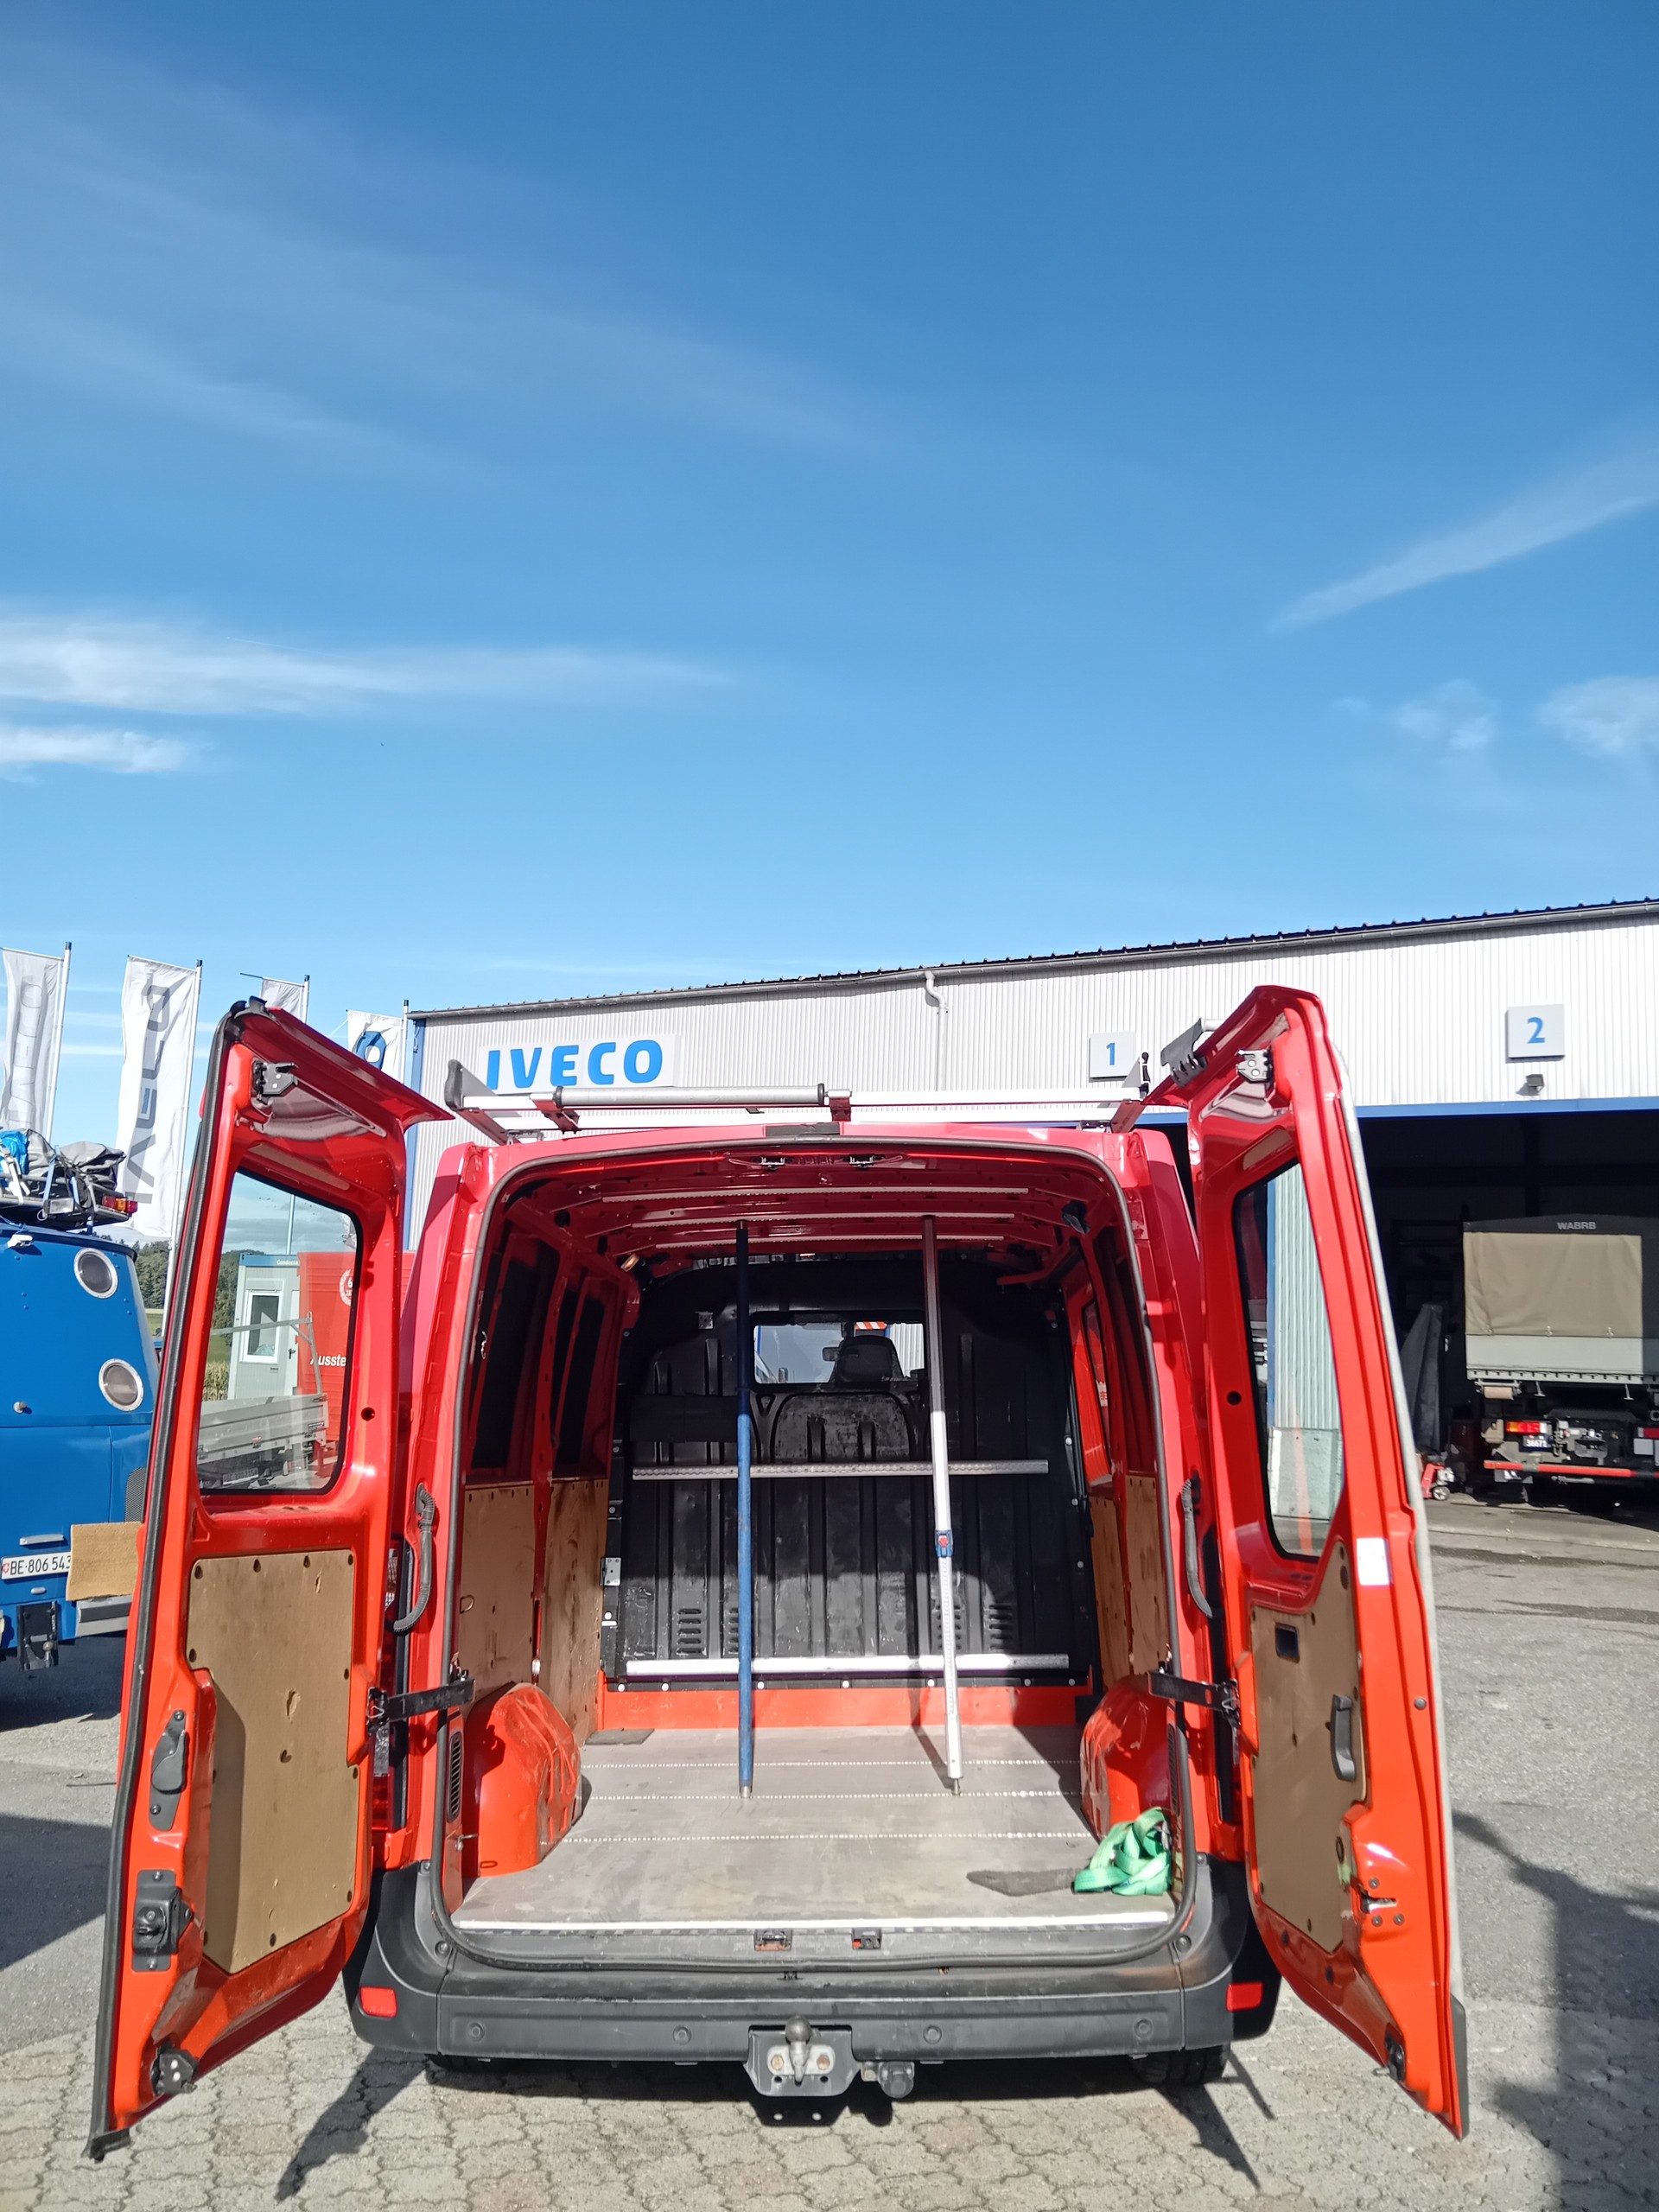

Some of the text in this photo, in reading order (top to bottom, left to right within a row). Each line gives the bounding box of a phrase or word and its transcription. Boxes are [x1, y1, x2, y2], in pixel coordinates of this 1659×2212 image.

[1527, 1016, 1546, 1044] 2
[486, 1039, 663, 1090] IVECO
[1106, 1042, 1116, 1065] 1
[1556, 1221, 1597, 1230] WABRB
